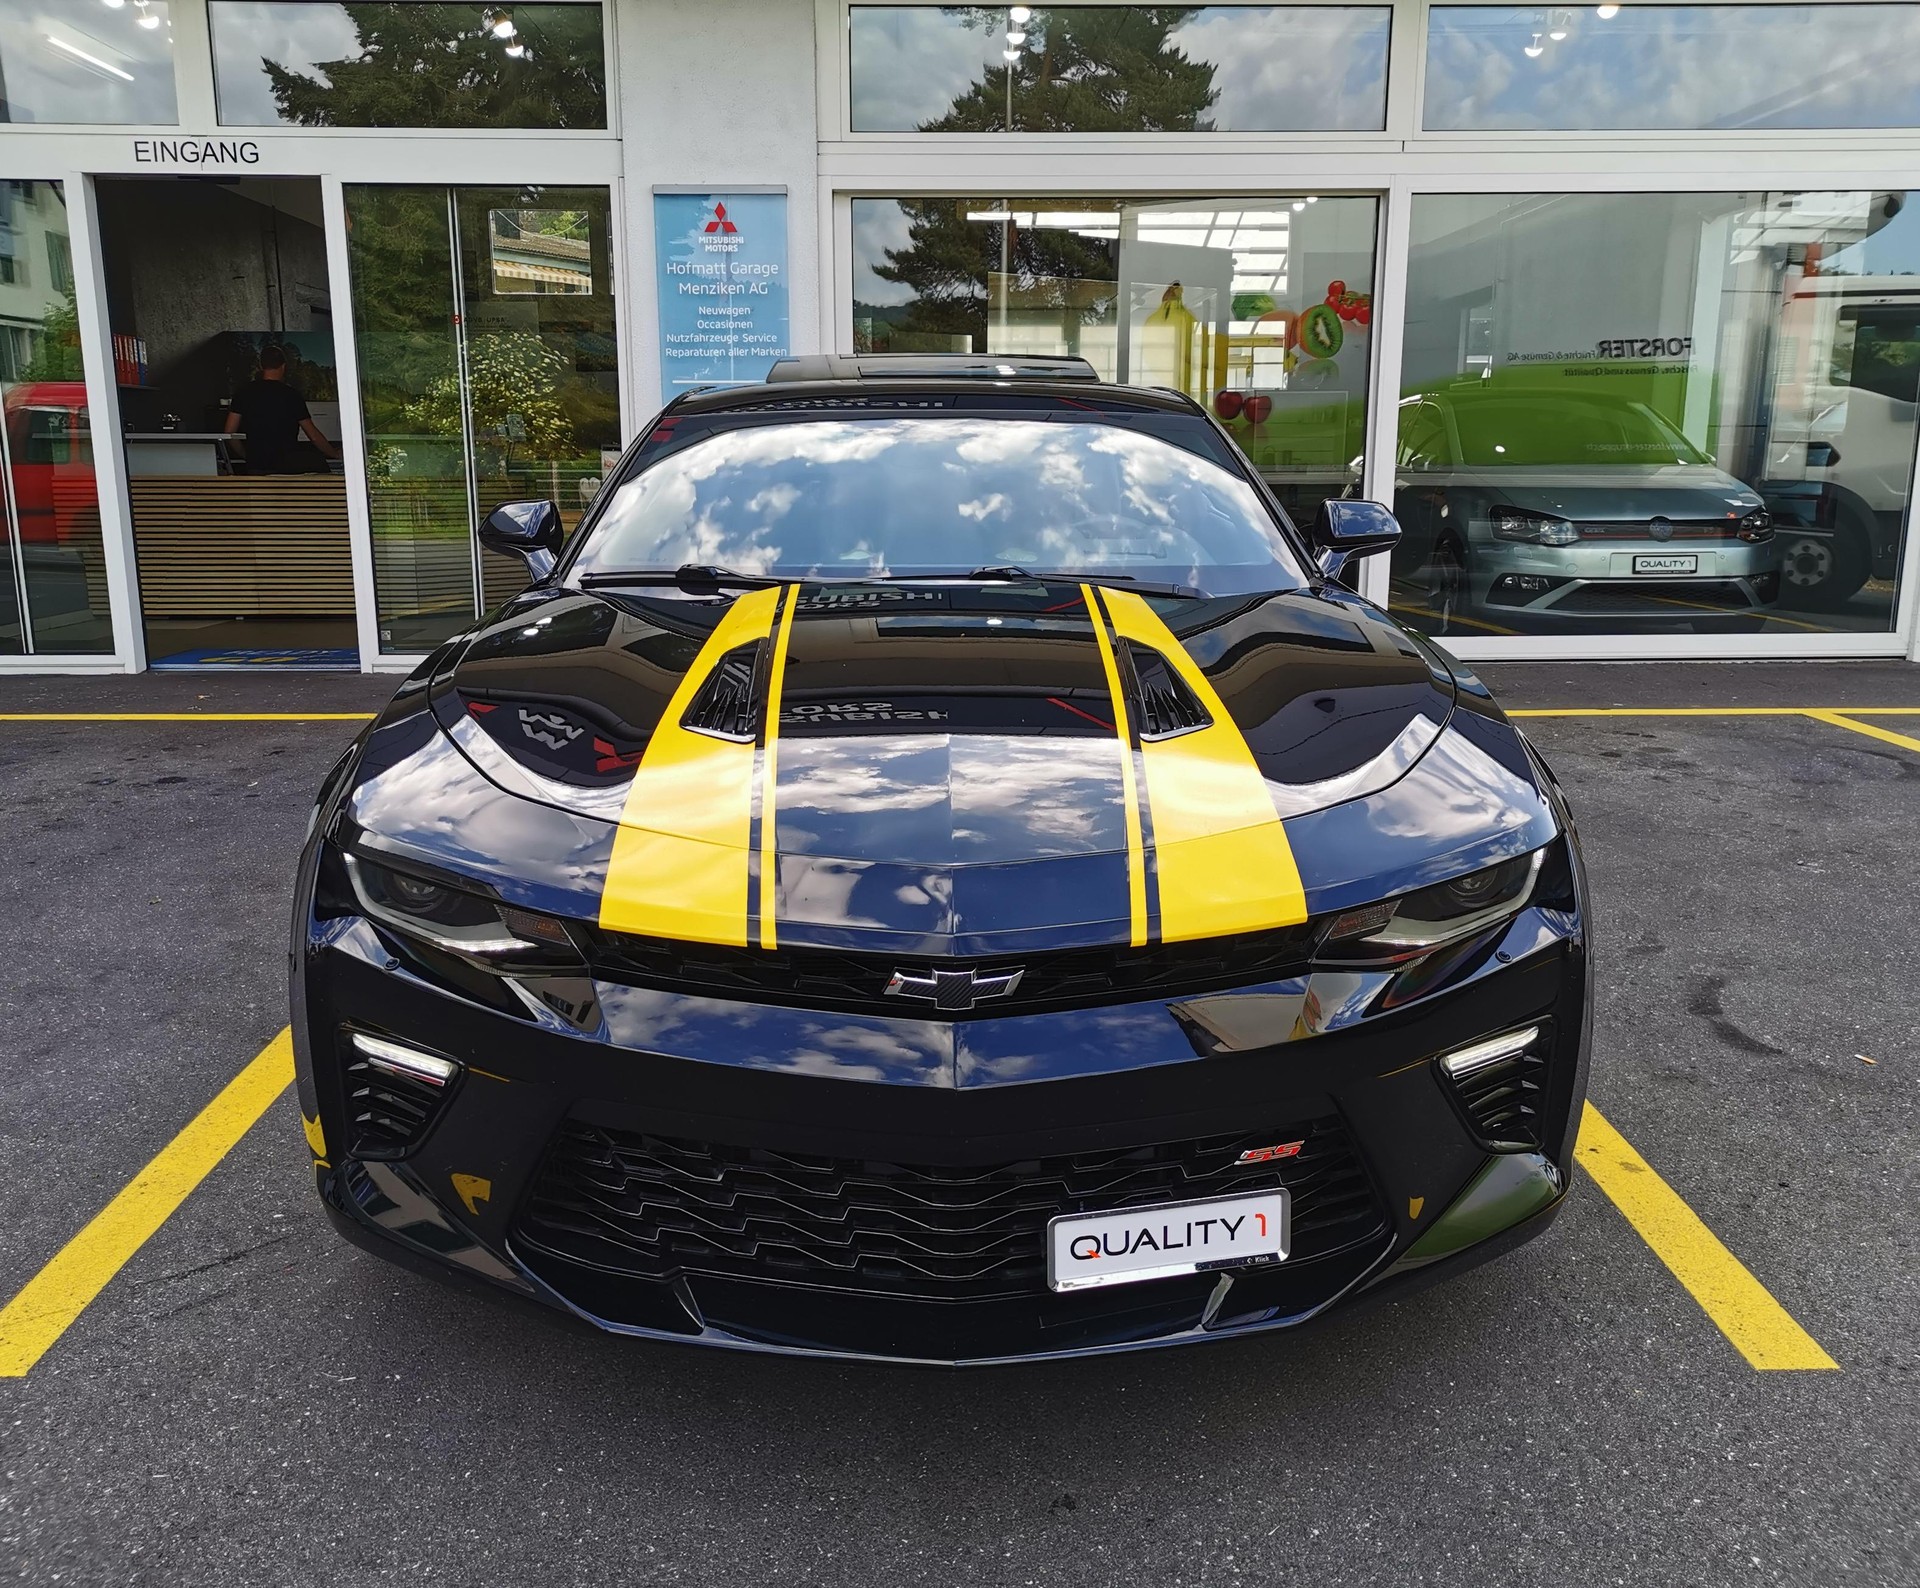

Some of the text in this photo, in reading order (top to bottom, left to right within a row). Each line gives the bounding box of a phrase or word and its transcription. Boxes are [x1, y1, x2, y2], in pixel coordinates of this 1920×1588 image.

[133, 140, 260, 164] EINGANG
[698, 236, 744, 244] MITSUBISHI
[704, 244, 739, 253] MOTORS
[666, 262, 779, 278] Hofmatt Garage
[679, 282, 768, 295] Menziken AG
[698, 306, 751, 317] Neuwagen
[697, 320, 753, 329] Occasionen
[666, 333, 778, 344] Nutzfahrzeuge Service
[665, 347, 787, 359] Reparaturen aller Marken
[1640, 560, 1686, 568] QUALITY
[1069, 1213, 1267, 1261] QUALITY 1
